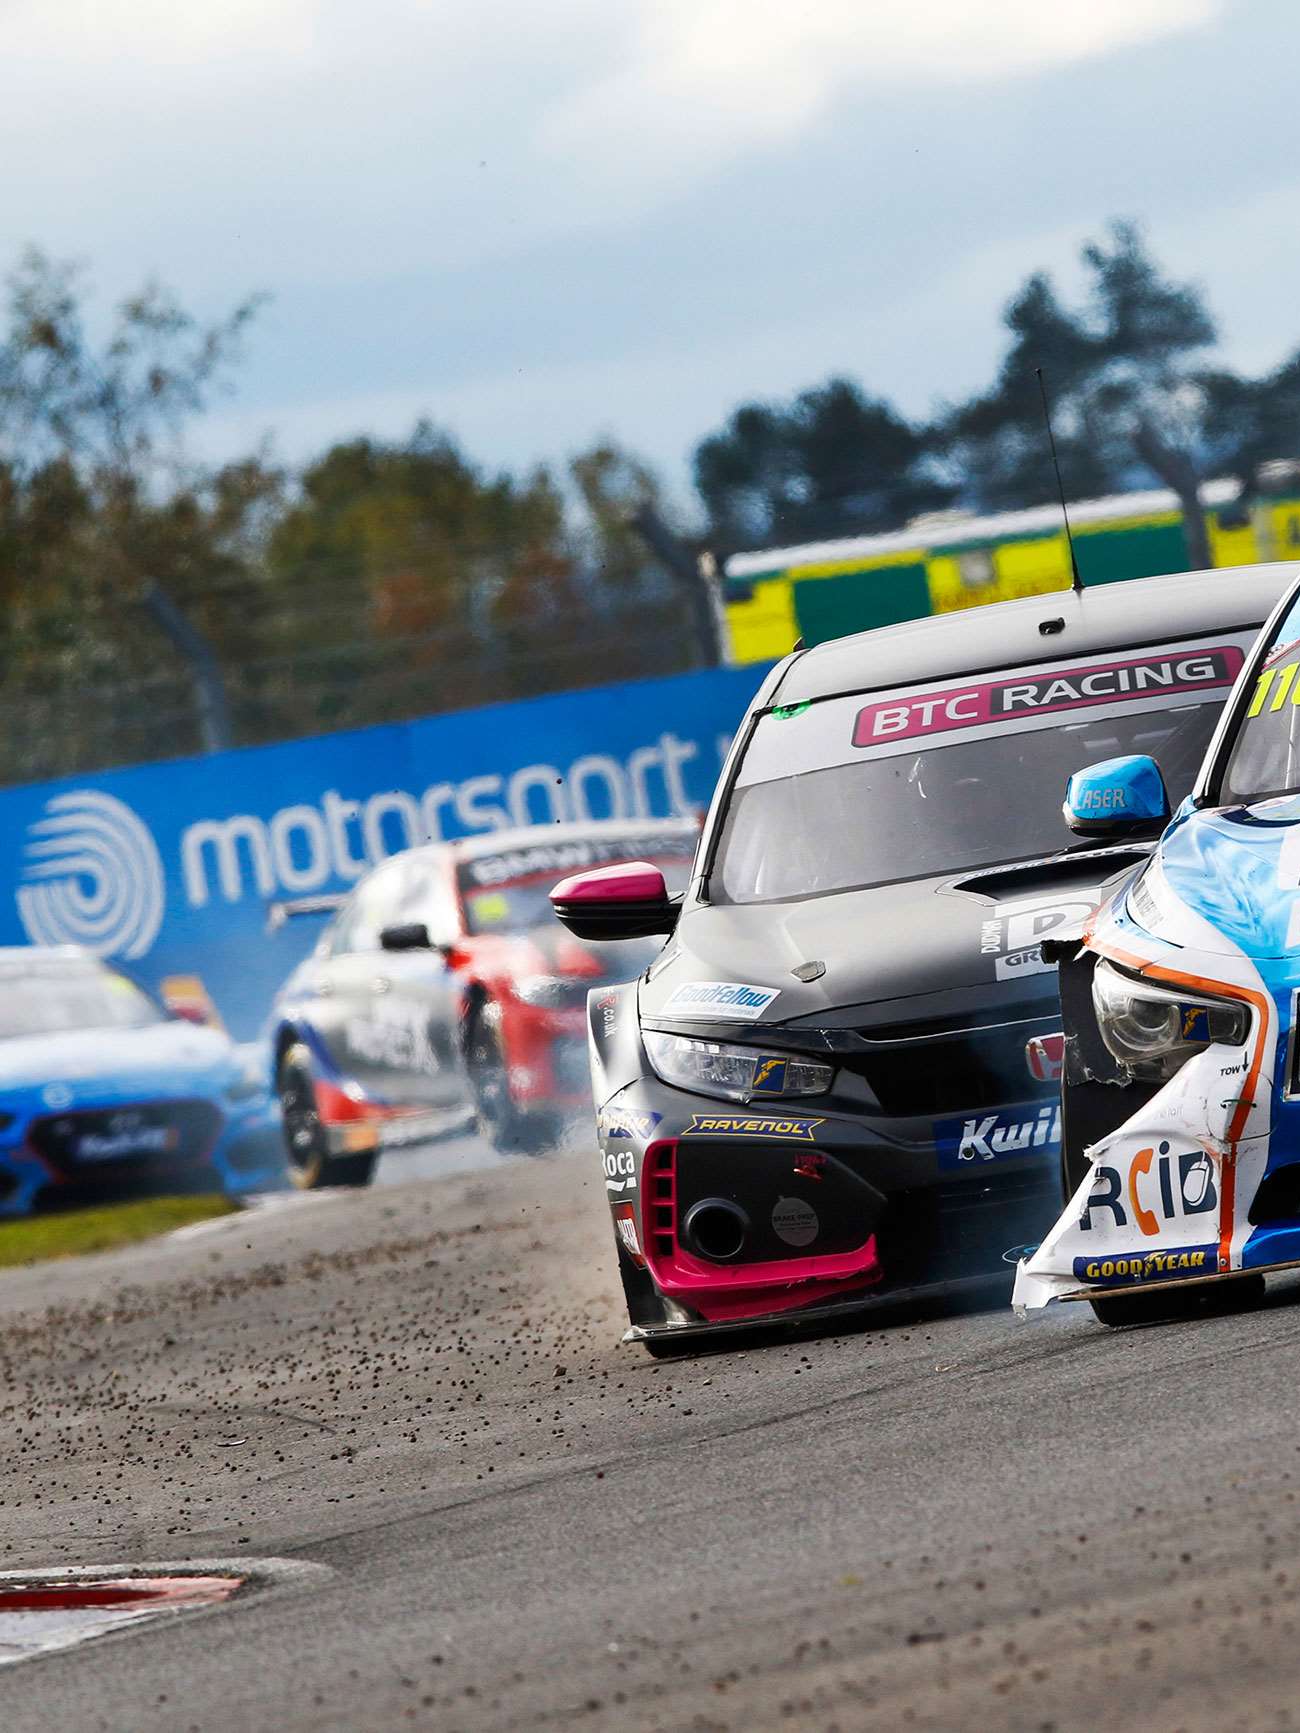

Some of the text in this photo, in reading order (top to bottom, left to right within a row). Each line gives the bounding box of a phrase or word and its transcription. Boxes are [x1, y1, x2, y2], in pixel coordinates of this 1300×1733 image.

[872, 656, 1216, 737] BTC RACING
[1072, 788, 1126, 810] LASER
[1005, 949, 1042, 967] GR
[1220, 1065, 1241, 1077] TOW
[699, 1118, 806, 1134] RAVENOL
[957, 1105, 1062, 1161] Kwi
